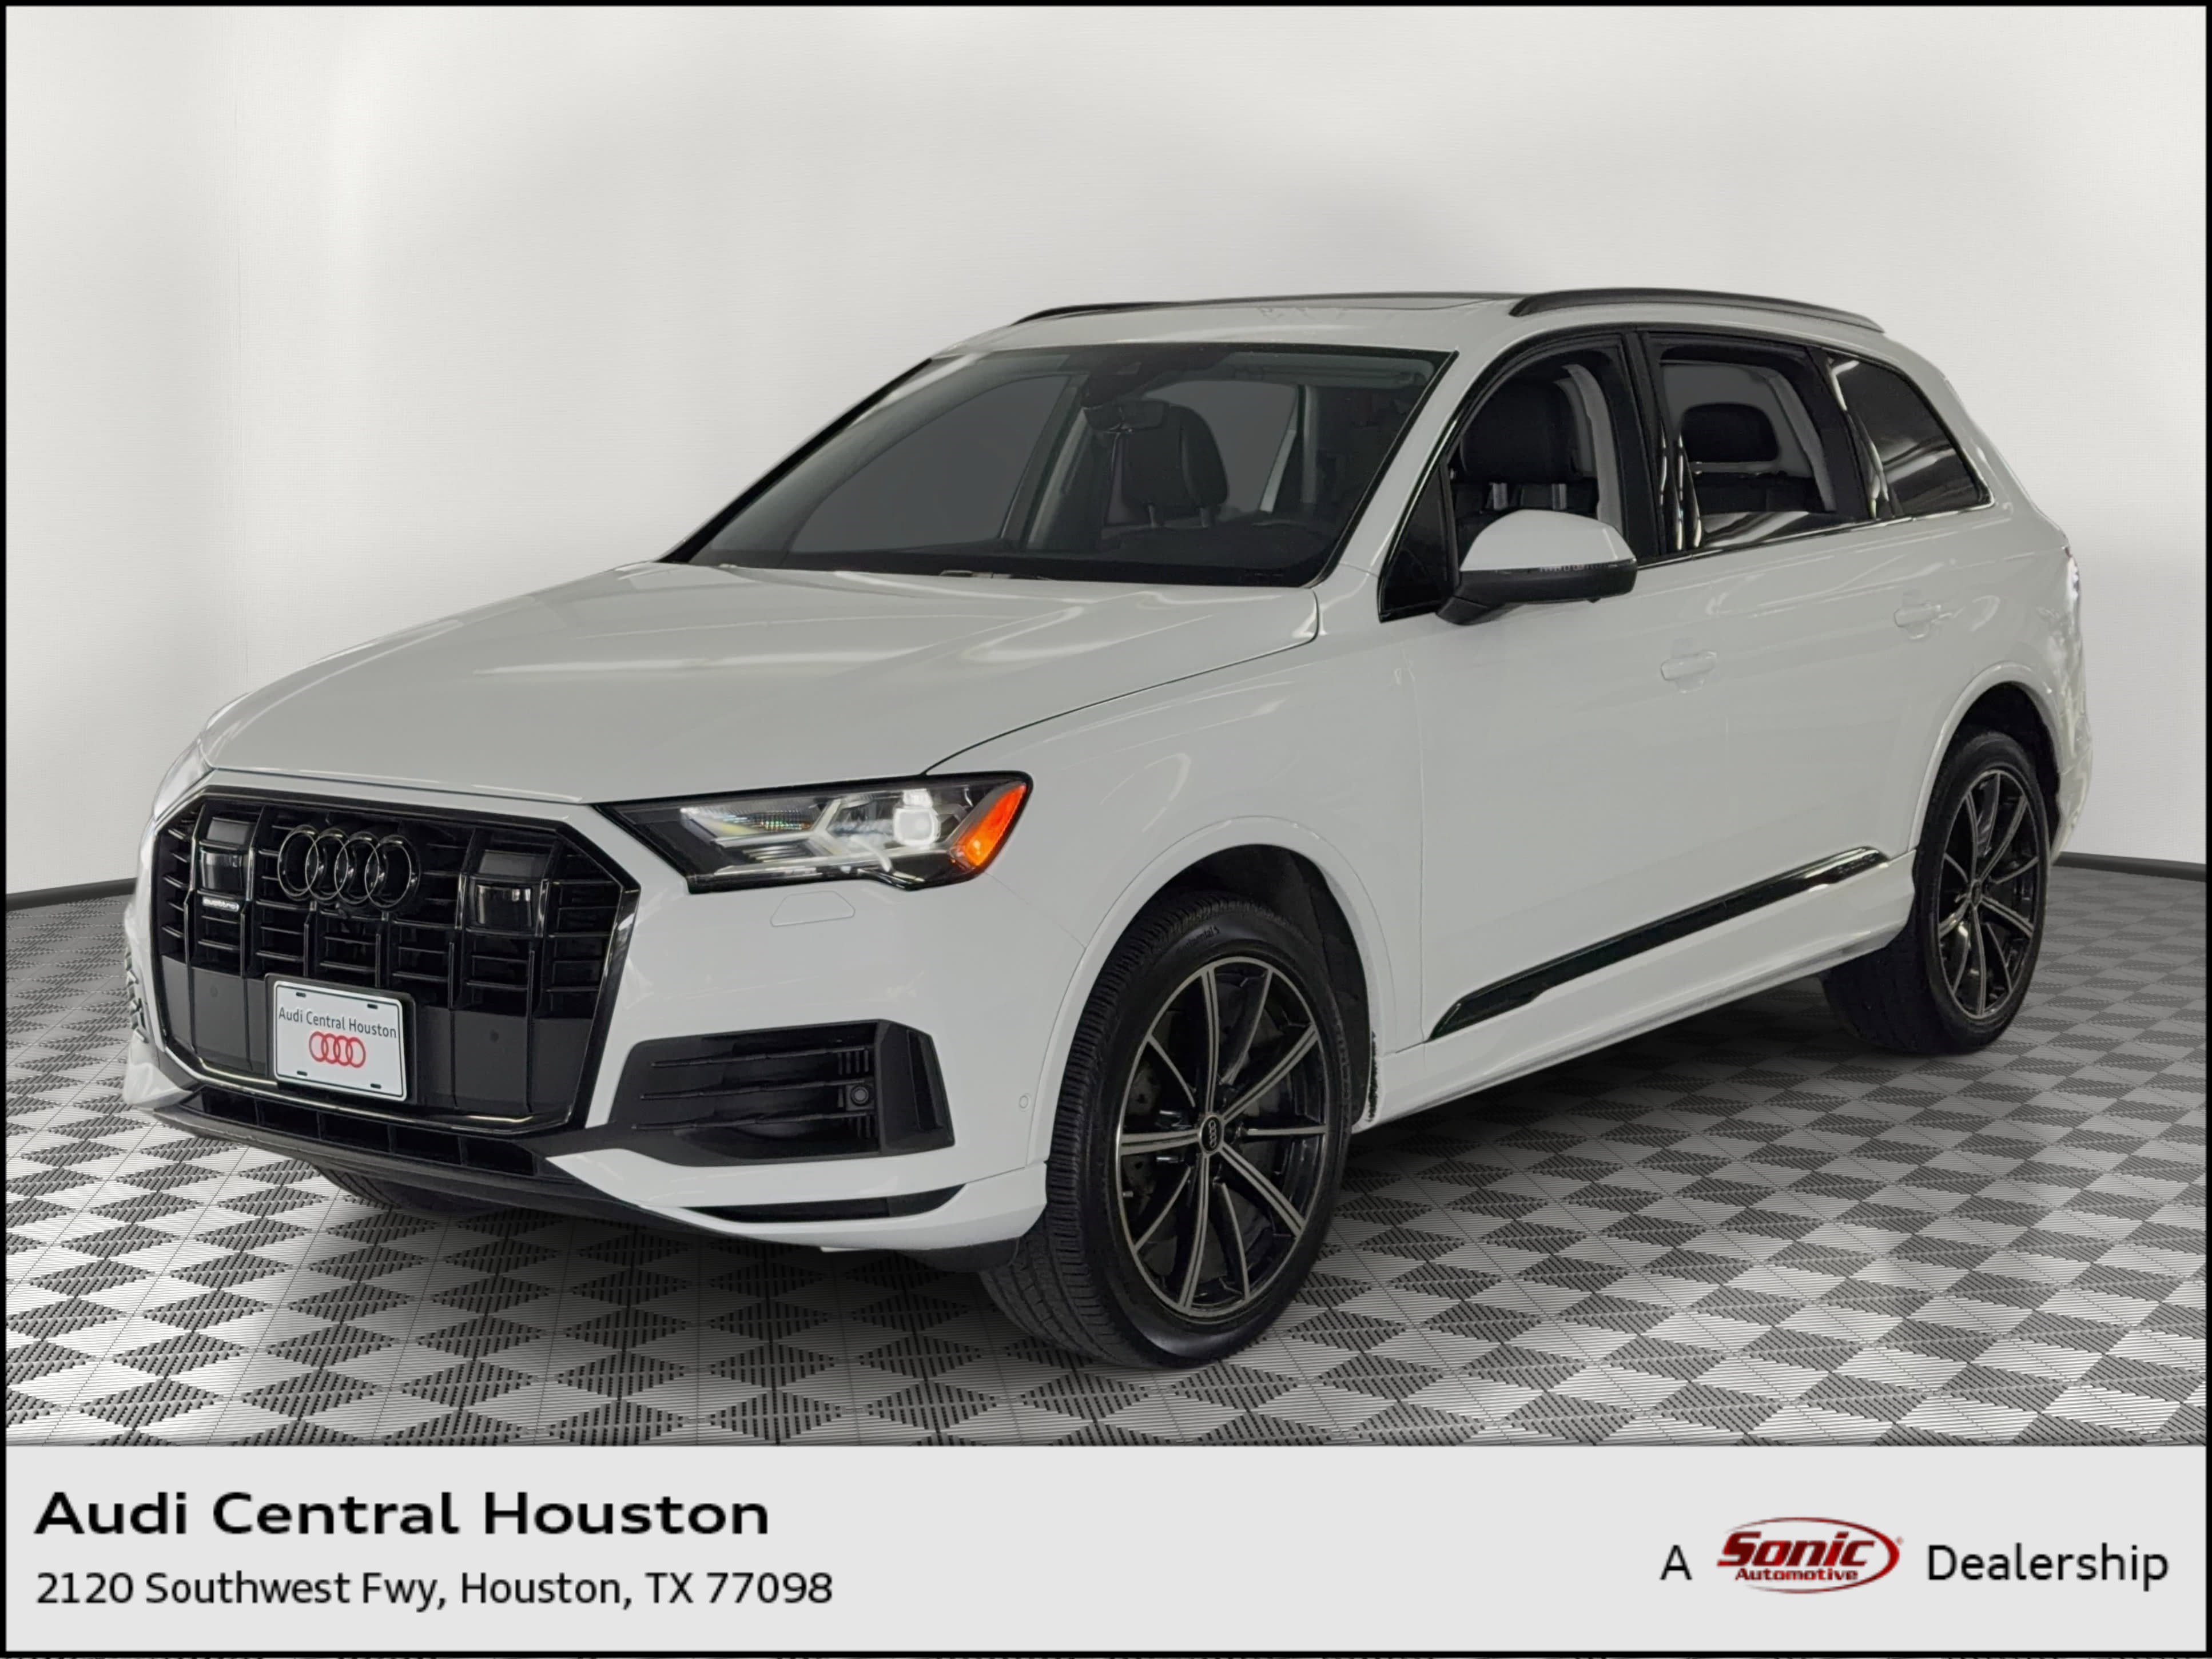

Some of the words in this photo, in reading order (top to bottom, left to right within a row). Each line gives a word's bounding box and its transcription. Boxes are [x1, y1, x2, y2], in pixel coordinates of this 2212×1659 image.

[279, 1006, 303, 1023] Audi
[306, 1011, 345, 1030] Central
[349, 1017, 397, 1039] Houston
